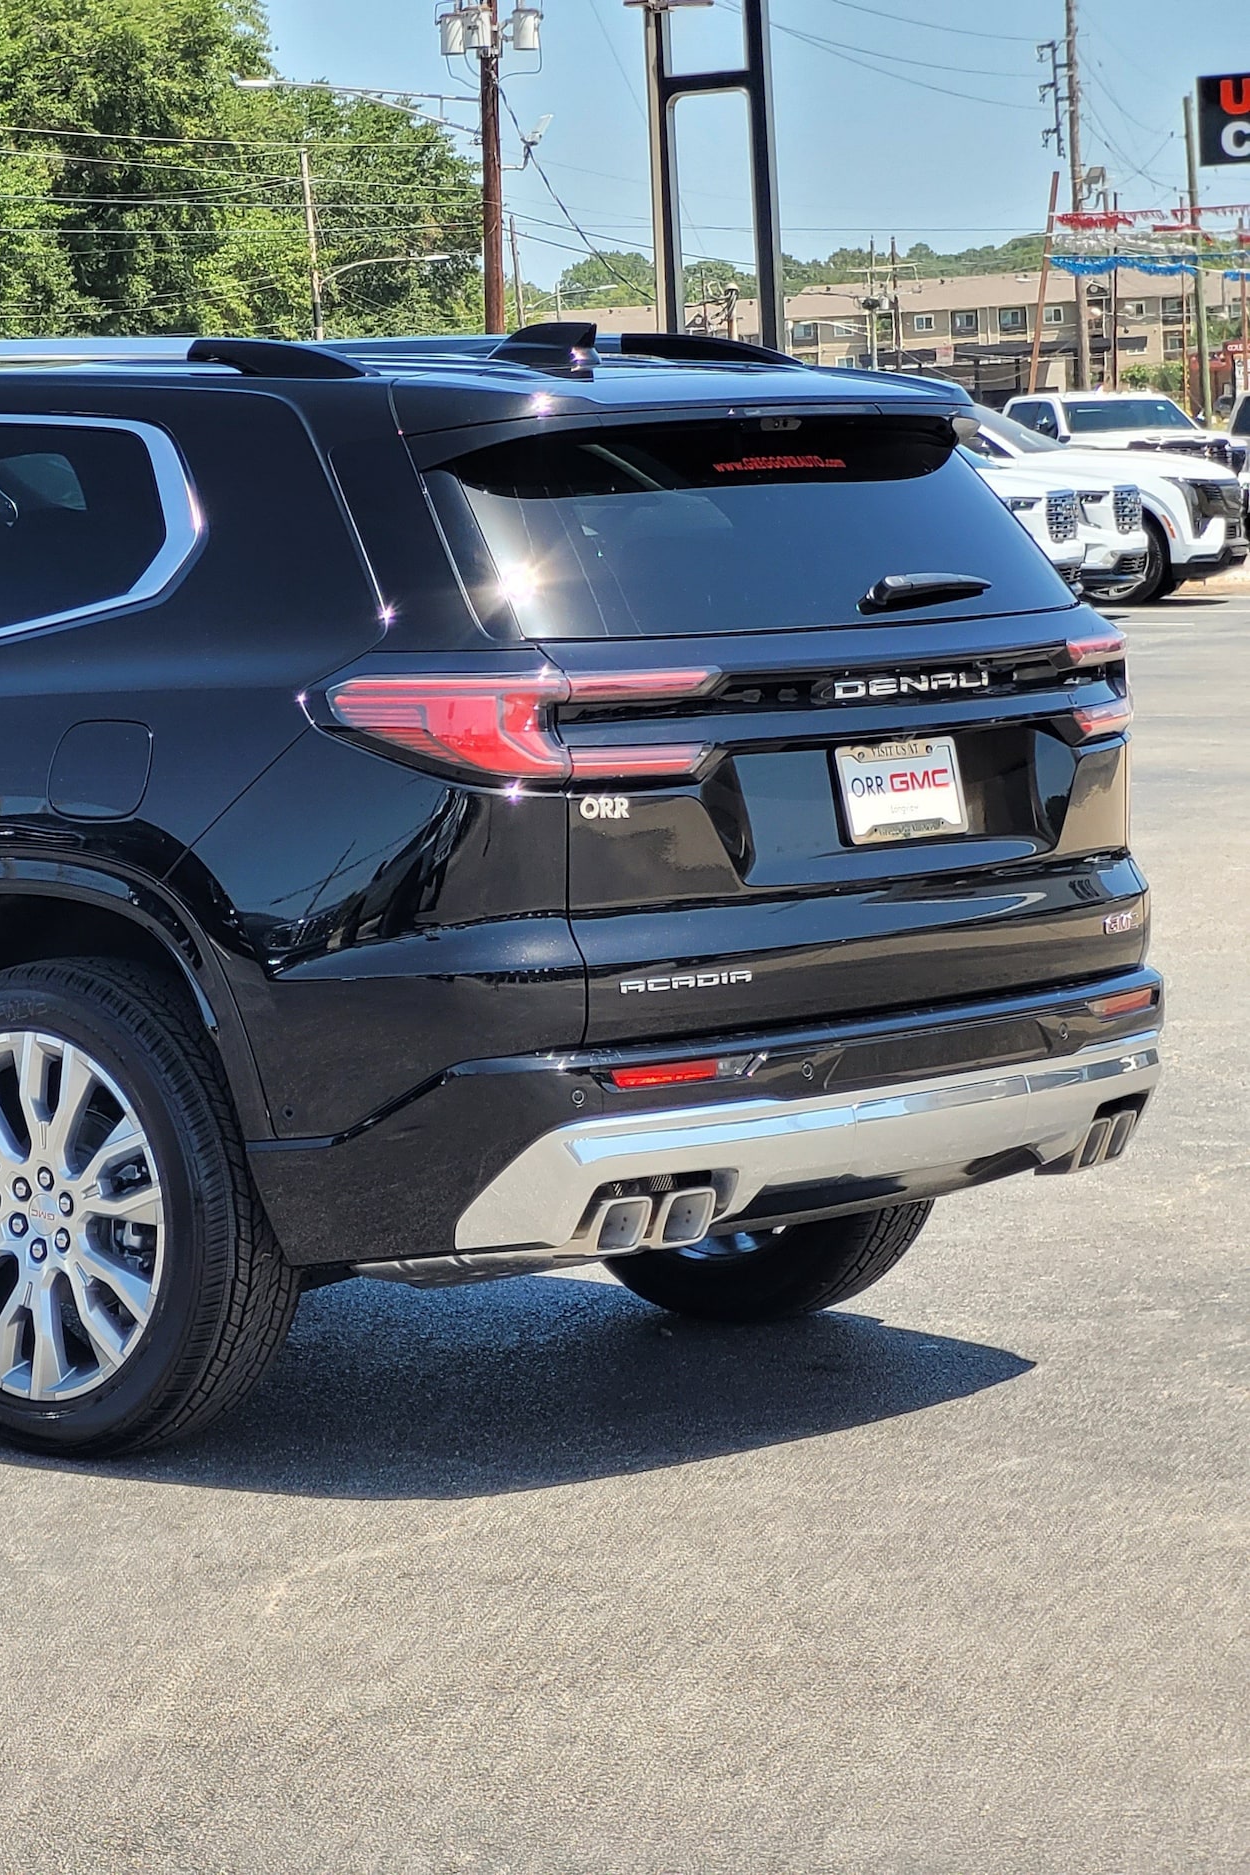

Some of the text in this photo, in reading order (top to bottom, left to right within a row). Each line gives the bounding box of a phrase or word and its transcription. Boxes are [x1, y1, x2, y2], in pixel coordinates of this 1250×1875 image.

[834, 670, 989, 700] DENALI
[871, 742, 919, 757] VISIT US AT
[851, 768, 950, 798] ORR GMC
[579, 796, 630, 820] ORR
[619, 970, 753, 995] ACADIA
[30, 1208, 55, 1221] GMC
